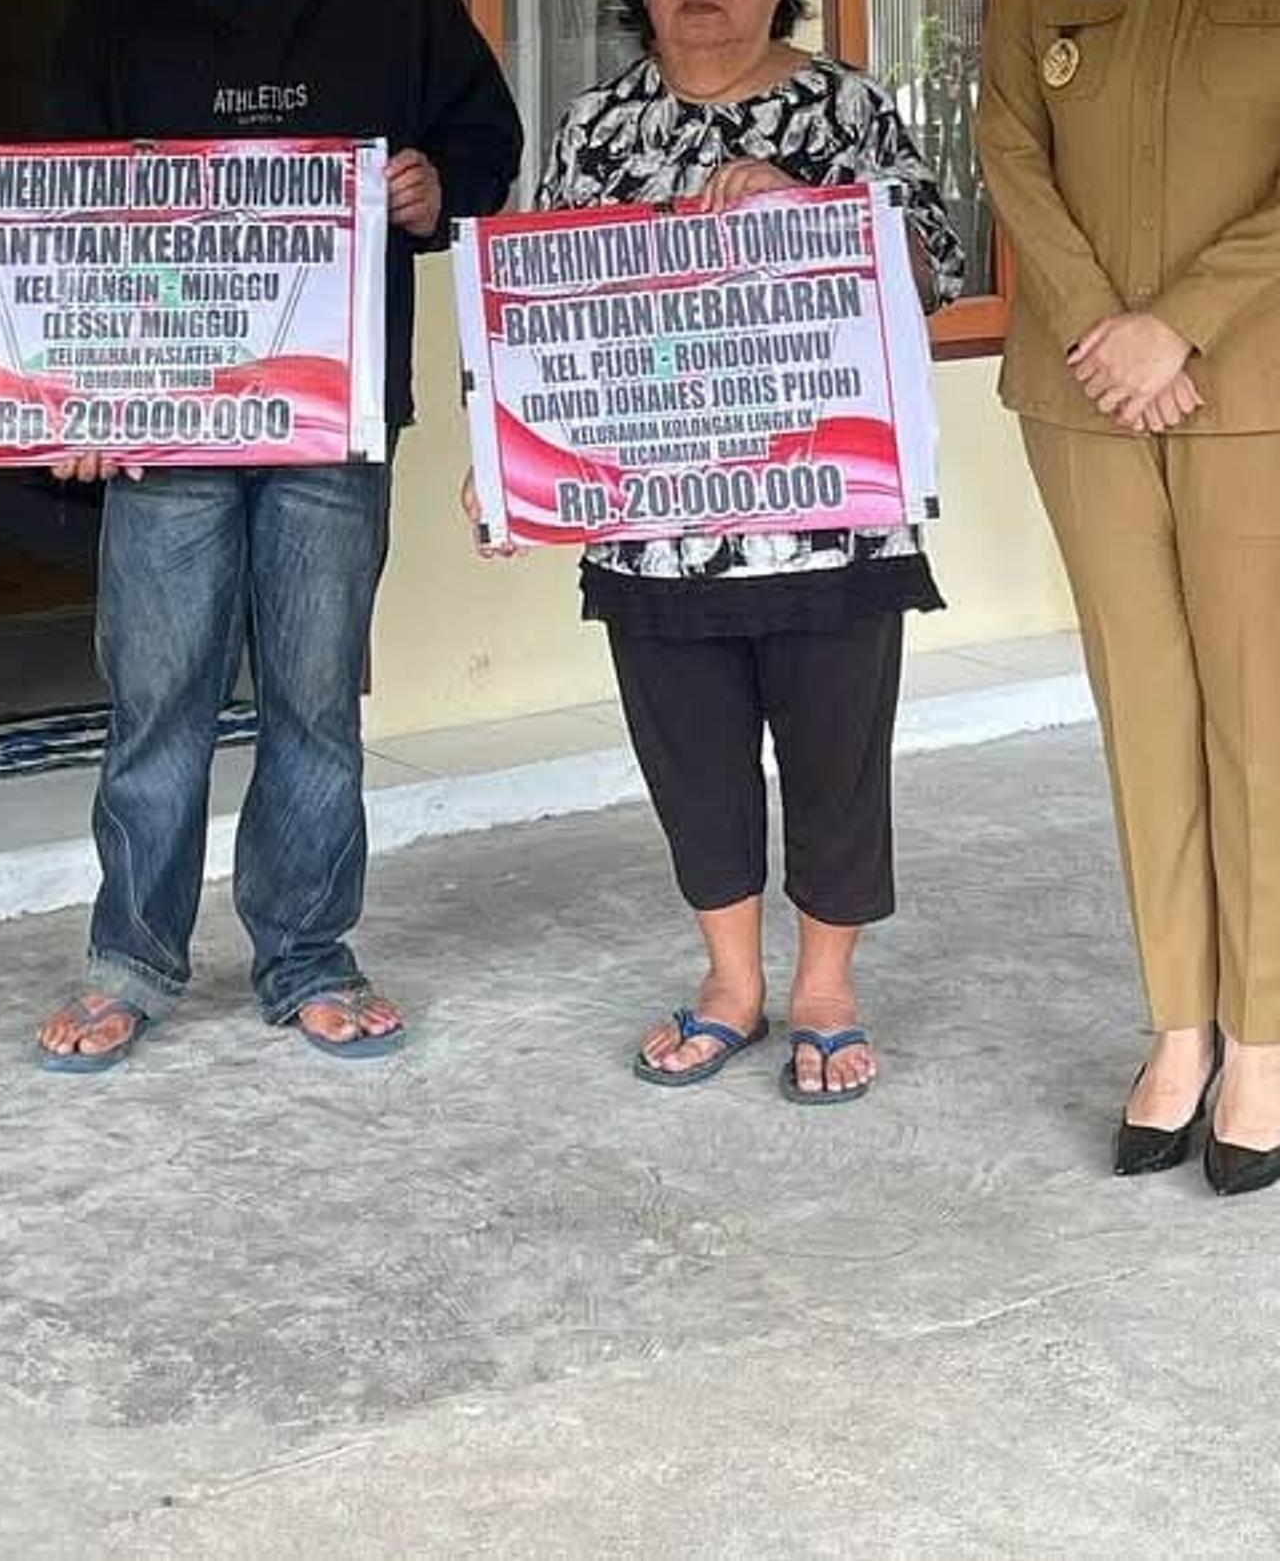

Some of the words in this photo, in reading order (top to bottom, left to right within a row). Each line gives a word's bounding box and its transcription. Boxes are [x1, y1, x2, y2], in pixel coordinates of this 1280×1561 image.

[213, 83, 308, 114] ATHLETICS
[134, 155, 202, 206] KOTA
[211, 155, 343, 207] TOMOHON
[132, 225, 335, 264] KEBAKARAN
[492, 224, 650, 288] PEMERINTAH
[656, 217, 724, 274] KOTA
[726, 204, 861, 267] TOMOHON
[181, 272, 280, 302] MINGGU
[506, 295, 654, 346] BANTUAN
[661, 276, 862, 333] KEBAKARAN
[139, 309, 249, 339] MINGGU)
[541, 354, 587, 383] KEL.
[592, 347, 655, 380] PIJOH
[674, 331, 833, 373] RONDONUWU
[64, 398, 290, 441] 20.000.000
[522, 389, 600, 424] (DAVID
[605, 381, 706, 417] JOHANES
[711, 374, 778, 408] JORIS
[782, 367, 862, 402] PIJOH)
[558, 481, 617, 526] Rp.
[625, 464, 842, 519] 20.000.000
